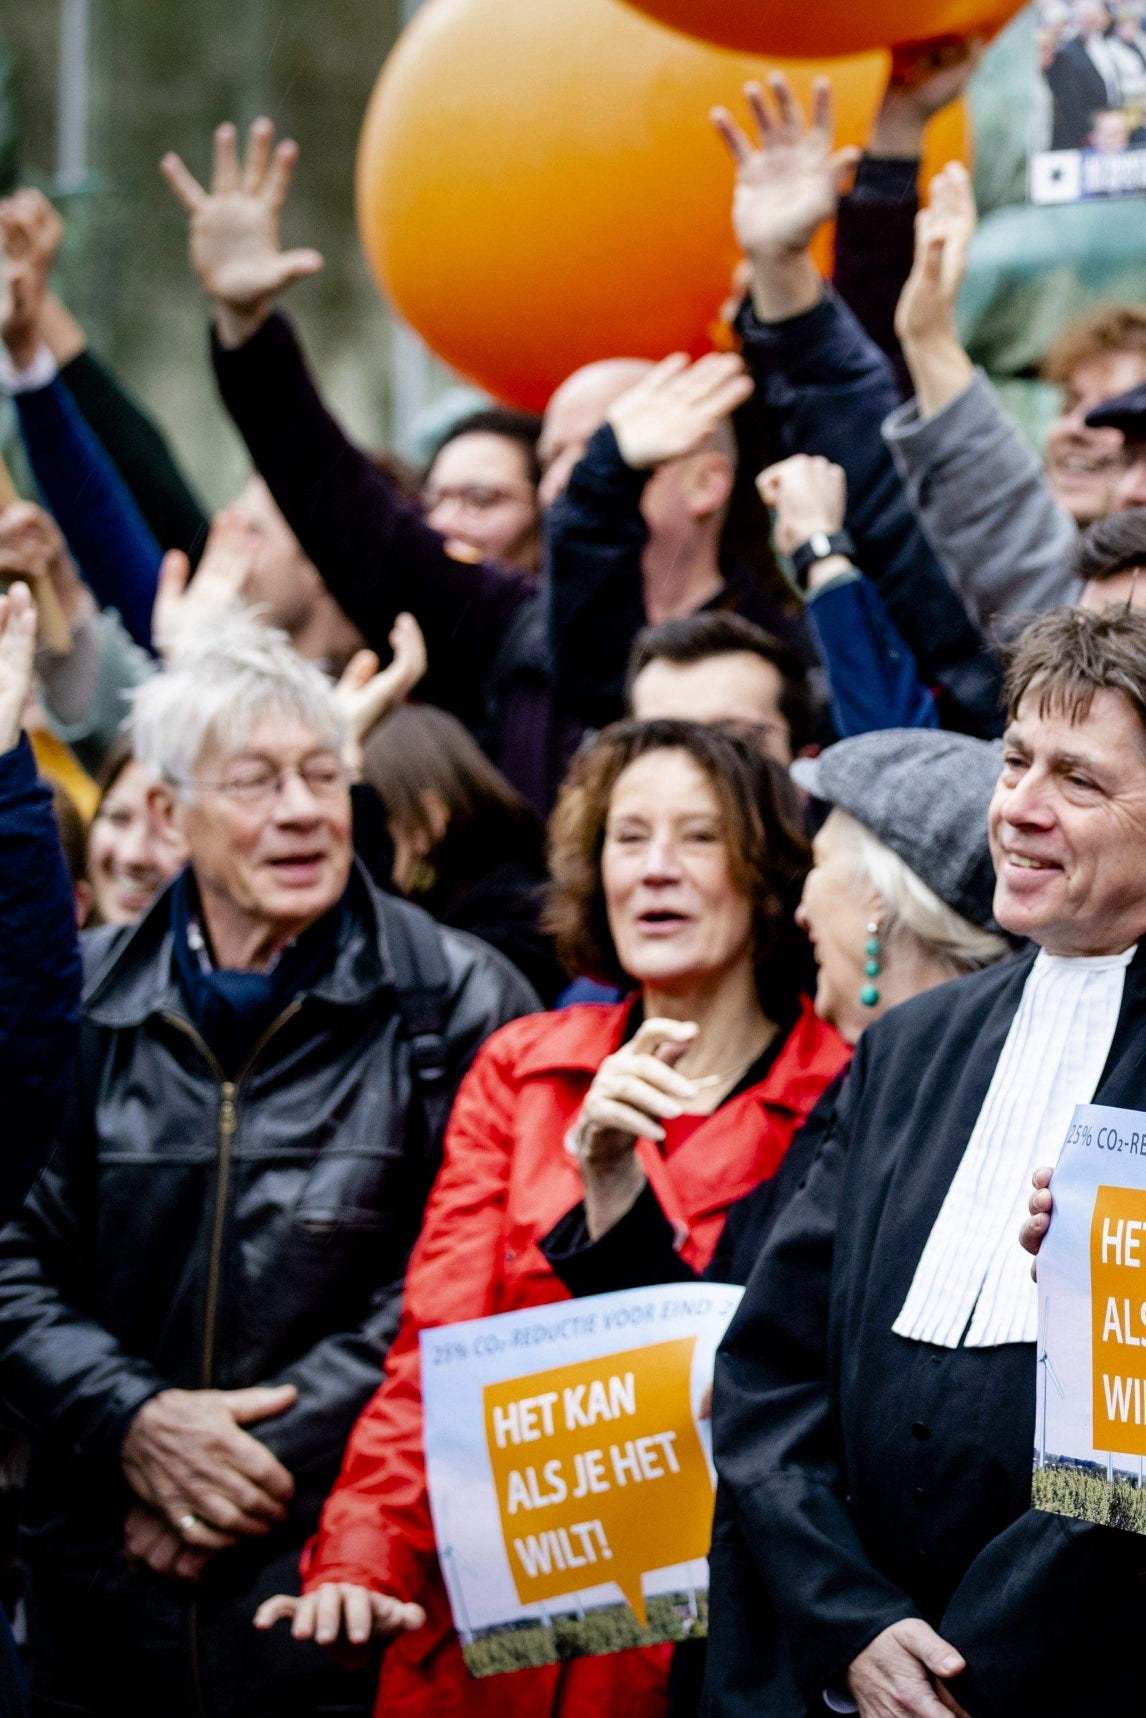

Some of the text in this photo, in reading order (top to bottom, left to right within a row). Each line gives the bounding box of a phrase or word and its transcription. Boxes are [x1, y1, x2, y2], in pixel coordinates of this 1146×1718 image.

[1066, 1124, 1093, 1147] 25%
[493, 1371, 637, 1449] HET KAN
[506, 1431, 681, 1516] ALS JE HET
[513, 1518, 614, 1578] WILT!
